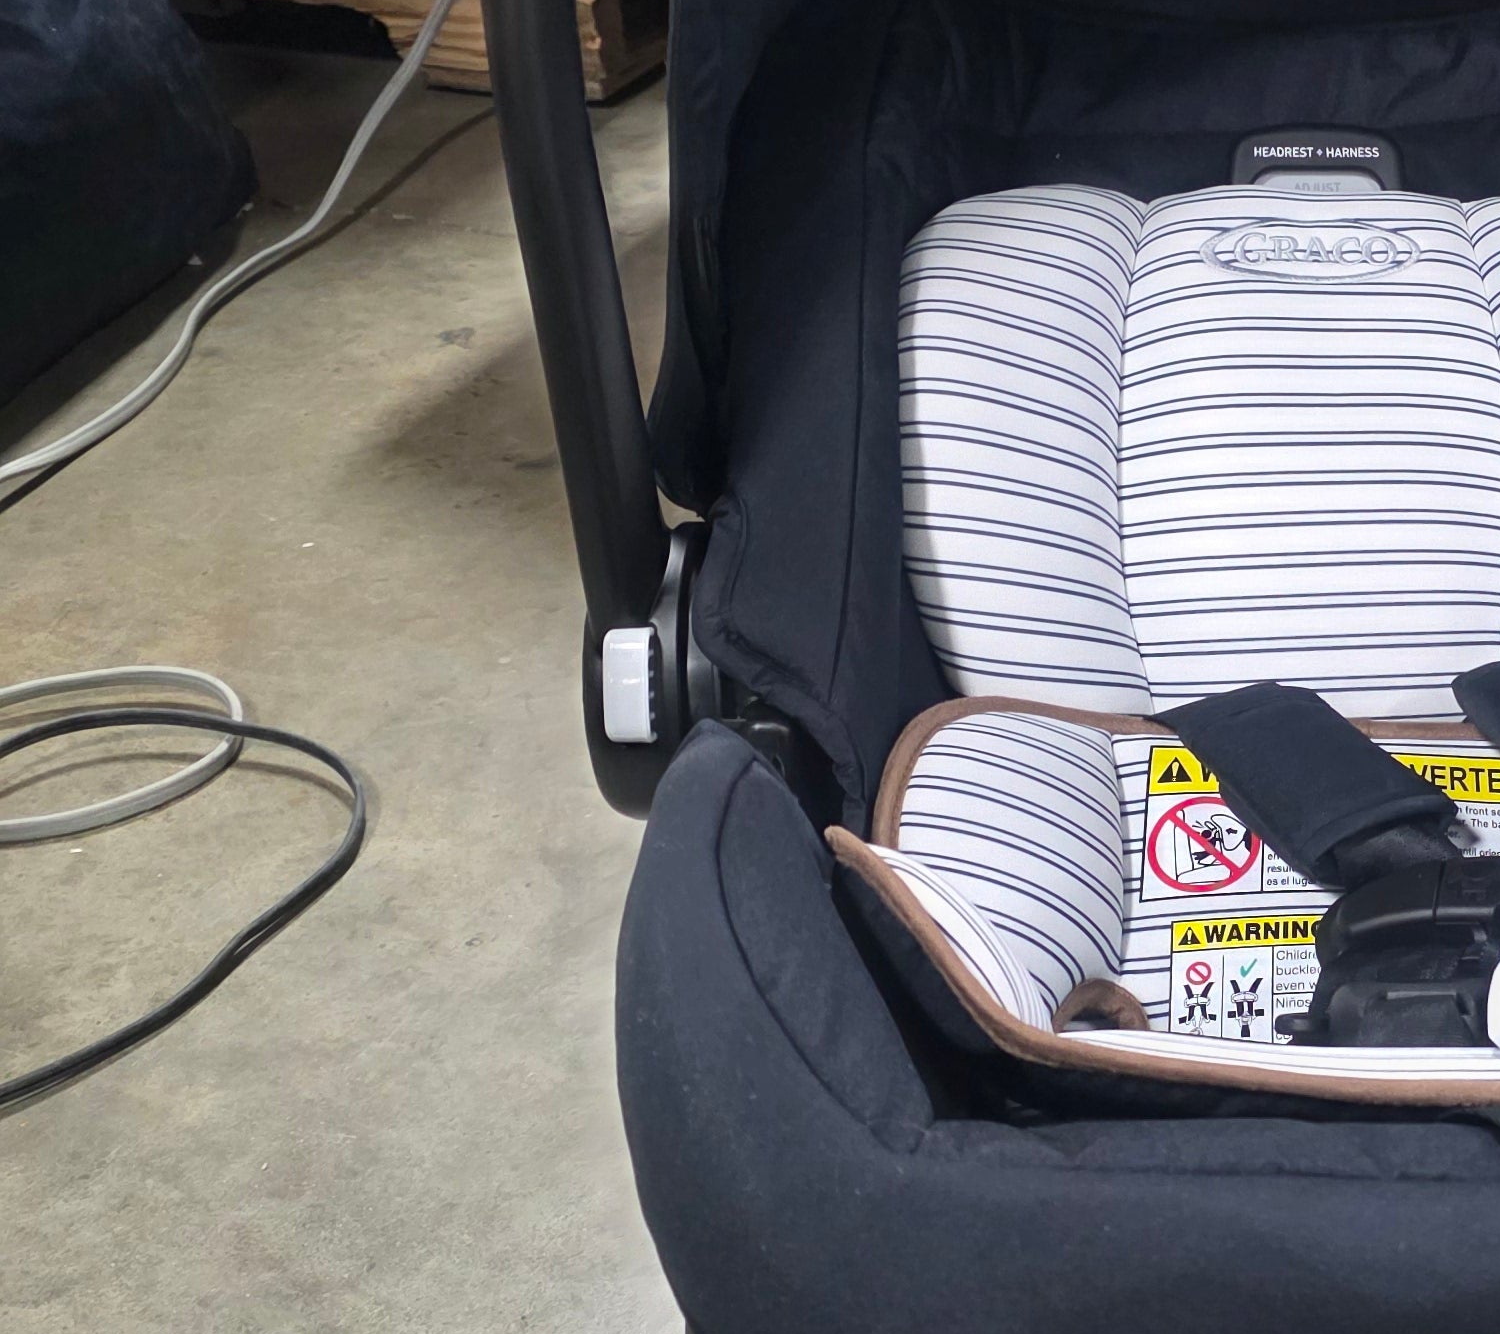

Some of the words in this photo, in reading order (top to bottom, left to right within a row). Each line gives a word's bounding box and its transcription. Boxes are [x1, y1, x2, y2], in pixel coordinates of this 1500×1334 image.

[1253, 146, 1314, 158] HEADREST
[1326, 147, 1380, 158] HARNESS
[1233, 232, 1398, 266] GRACO
[1465, 806, 1488, 816] front
[1471, 818, 1489, 828] The
[1267, 878, 1278, 886] es
[1281, 876, 1290, 886] el
[1276, 950, 1316, 961] Childr
[1275, 982, 1305, 991] even
